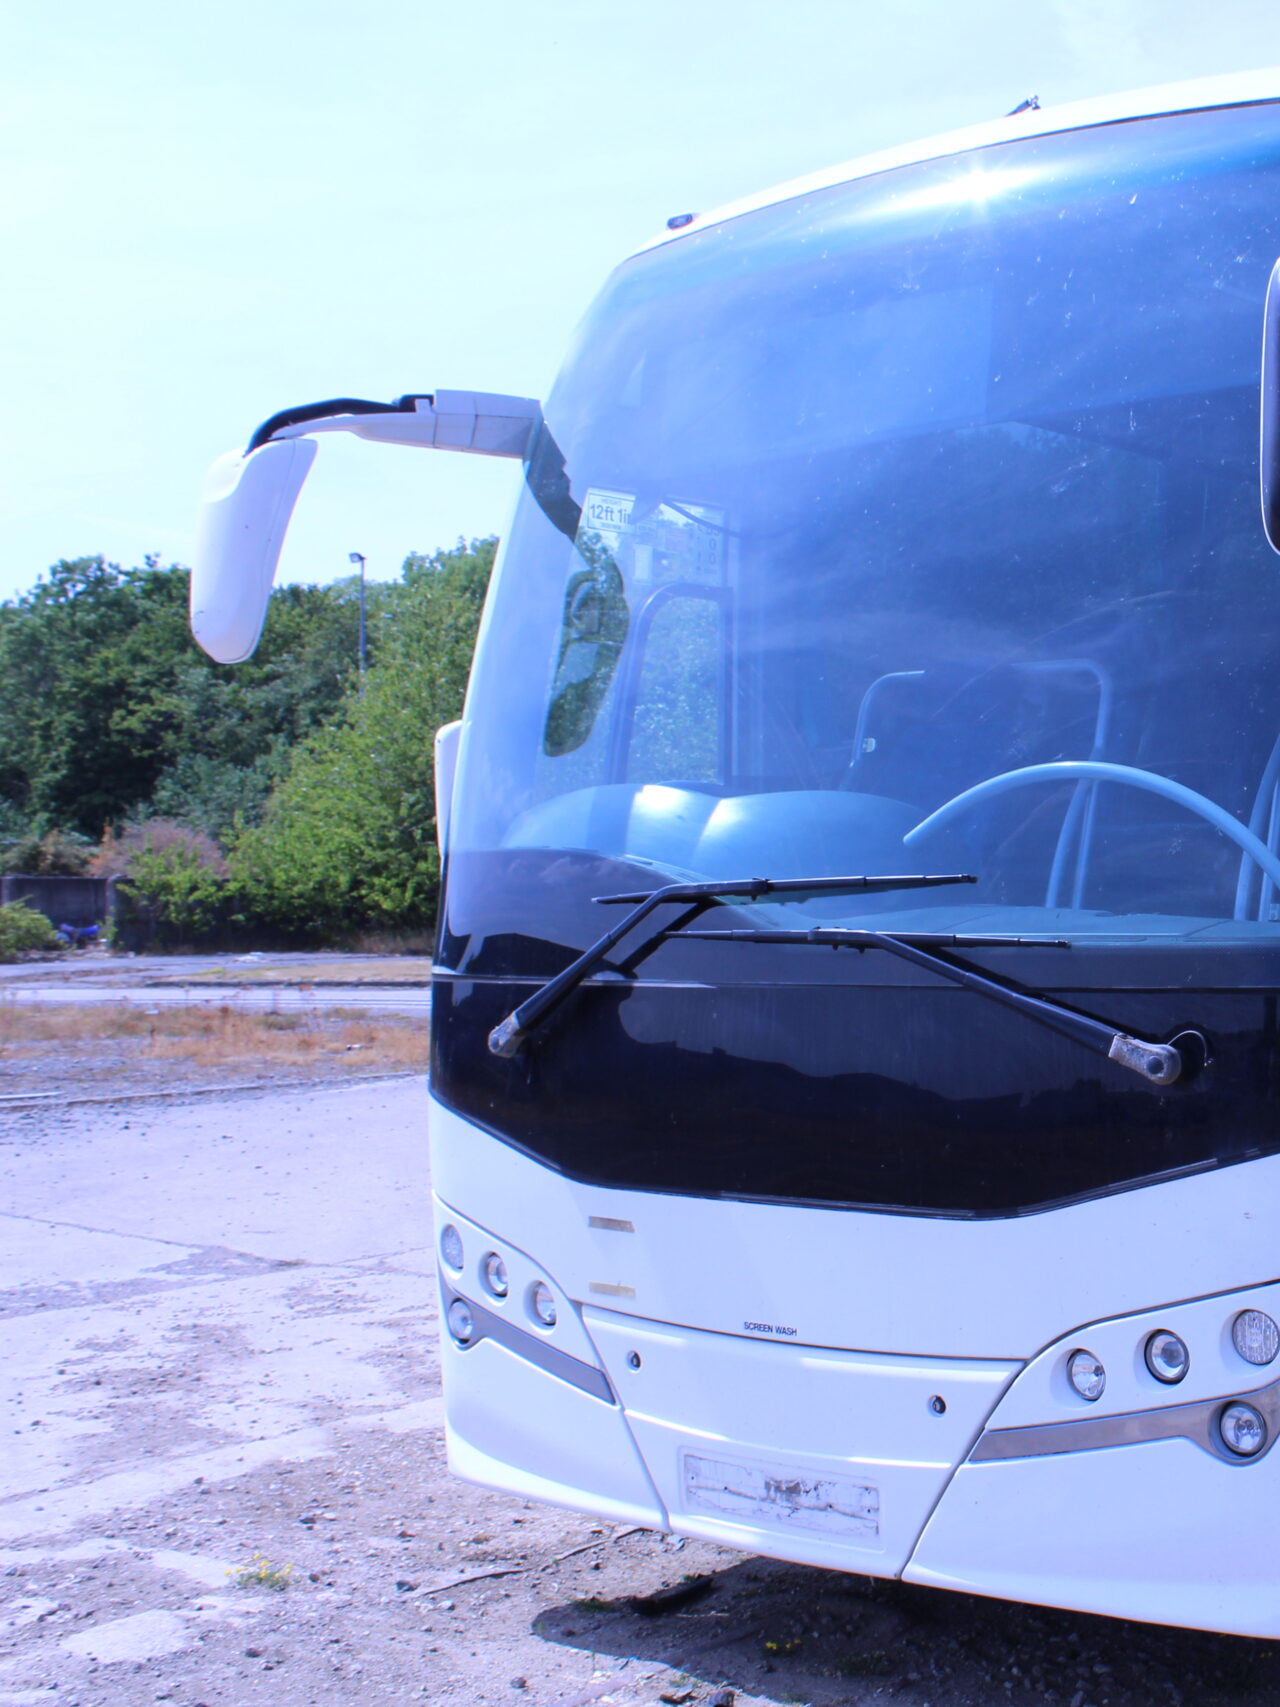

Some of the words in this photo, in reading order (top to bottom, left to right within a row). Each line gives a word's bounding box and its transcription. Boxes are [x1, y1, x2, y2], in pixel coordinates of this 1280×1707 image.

[590, 503, 614, 522] 12ft
[743, 1321, 774, 1333] SCREEN
[775, 1326, 798, 1336] WASH
